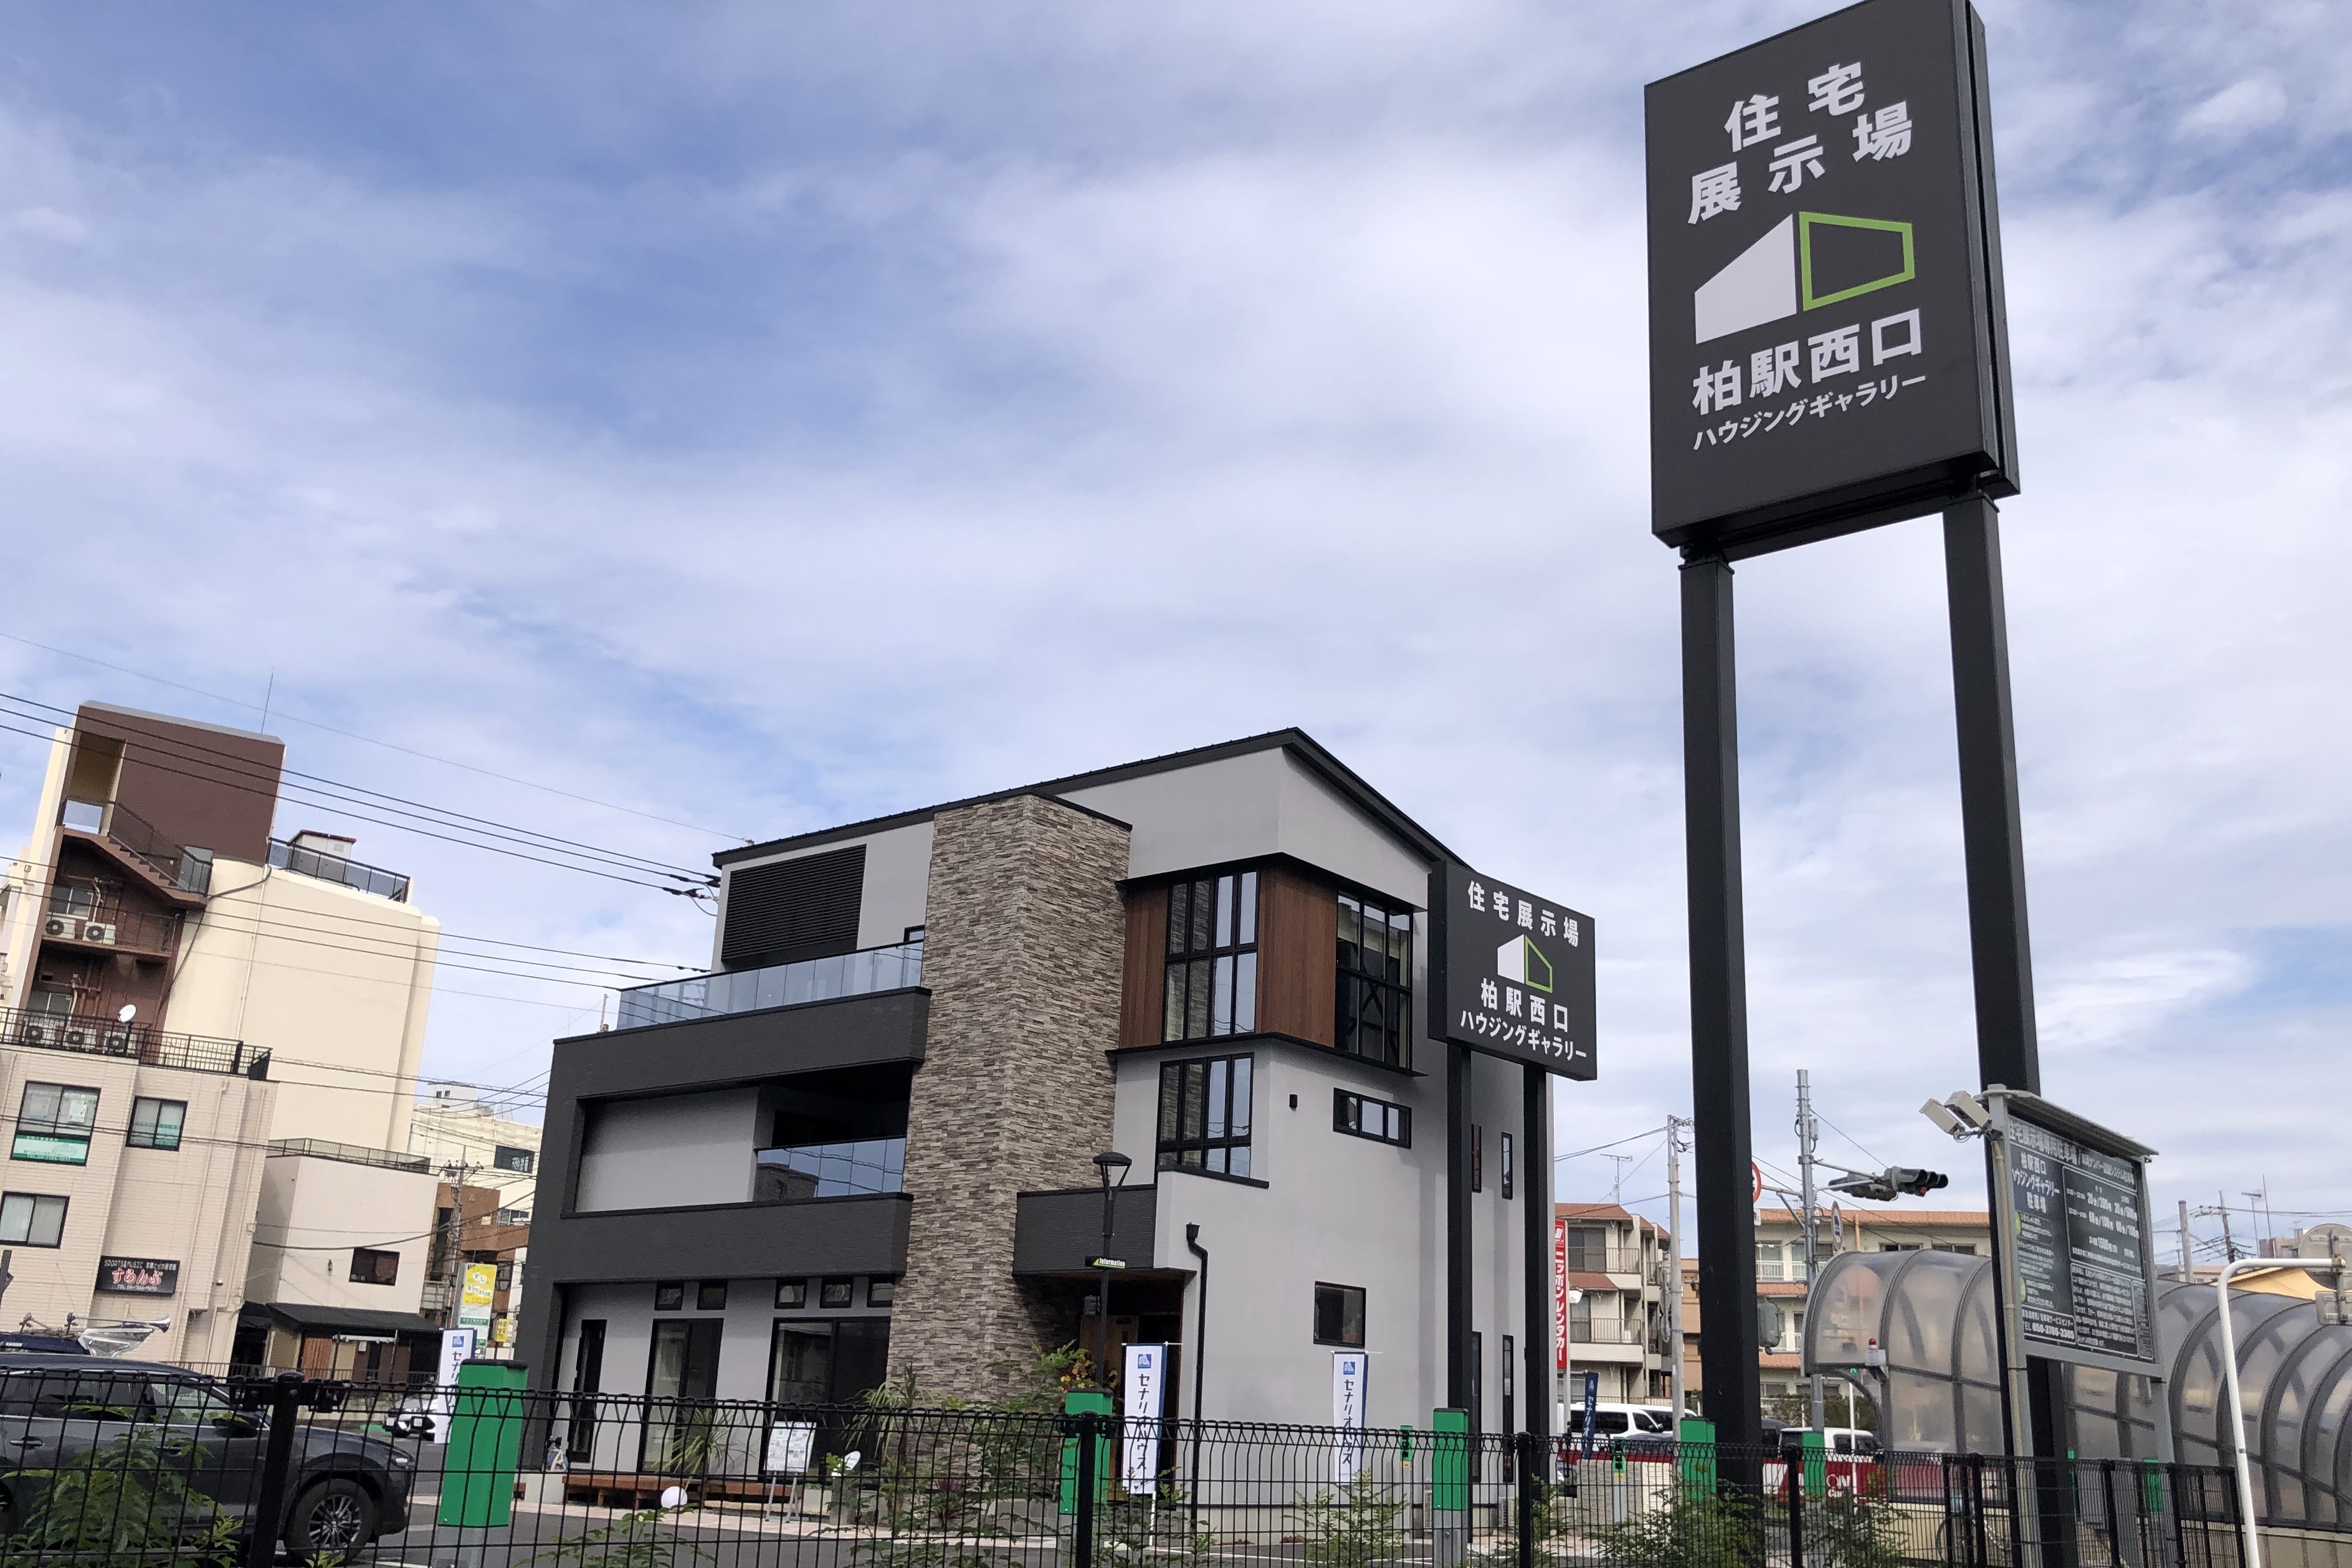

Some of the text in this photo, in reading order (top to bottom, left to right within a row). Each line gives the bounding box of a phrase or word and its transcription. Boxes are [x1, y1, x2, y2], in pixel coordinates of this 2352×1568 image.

[1724, 61, 1865, 153] 住宅
[1688, 101, 1913, 224] 展示場
[1692, 308, 1923, 416] 柏駅西口
[1693, 374, 1926, 450] ハウジングギャラリー
[1468, 880, 1578, 947] 住宅展示場
[1460, 1010, 1586, 1061] ハウジングギャラリー
[1481, 978, 1568, 1032] 柏駅西口
[1099, 1257, 1126, 1267] Information
